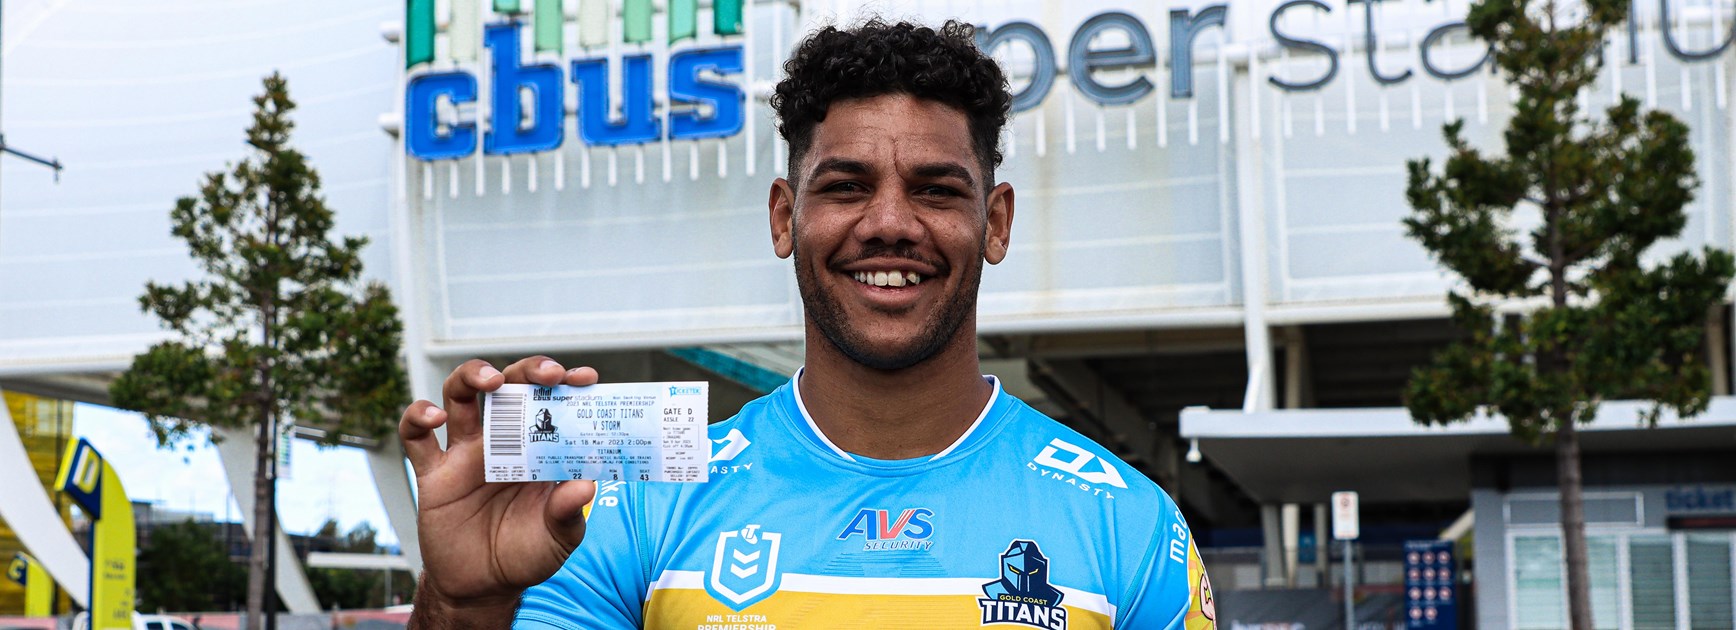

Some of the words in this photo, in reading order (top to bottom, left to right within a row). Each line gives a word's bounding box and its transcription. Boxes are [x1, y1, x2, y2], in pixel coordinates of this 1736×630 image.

[406, 21, 745, 160] cbus
[975, 5, 1228, 113] per
[552, 395, 573, 403] super
[577, 408, 593, 418] GOLD
[597, 408, 616, 418] COAST
[620, 408, 644, 418] TITANS
[593, 421, 598, 431] V
[601, 421, 621, 431] STORM
[529, 433, 559, 443] TITANS
[73, 445, 99, 494] D
[710, 462, 752, 474] ASTY
[1026, 462, 1115, 499] DYNASTY
[838, 508, 934, 540] AVS
[864, 540, 934, 551] SECURITY
[1000, 594, 1022, 602] GOLD
[1023, 596, 1048, 605] COAST
[978, 600, 1065, 630] TITANS
